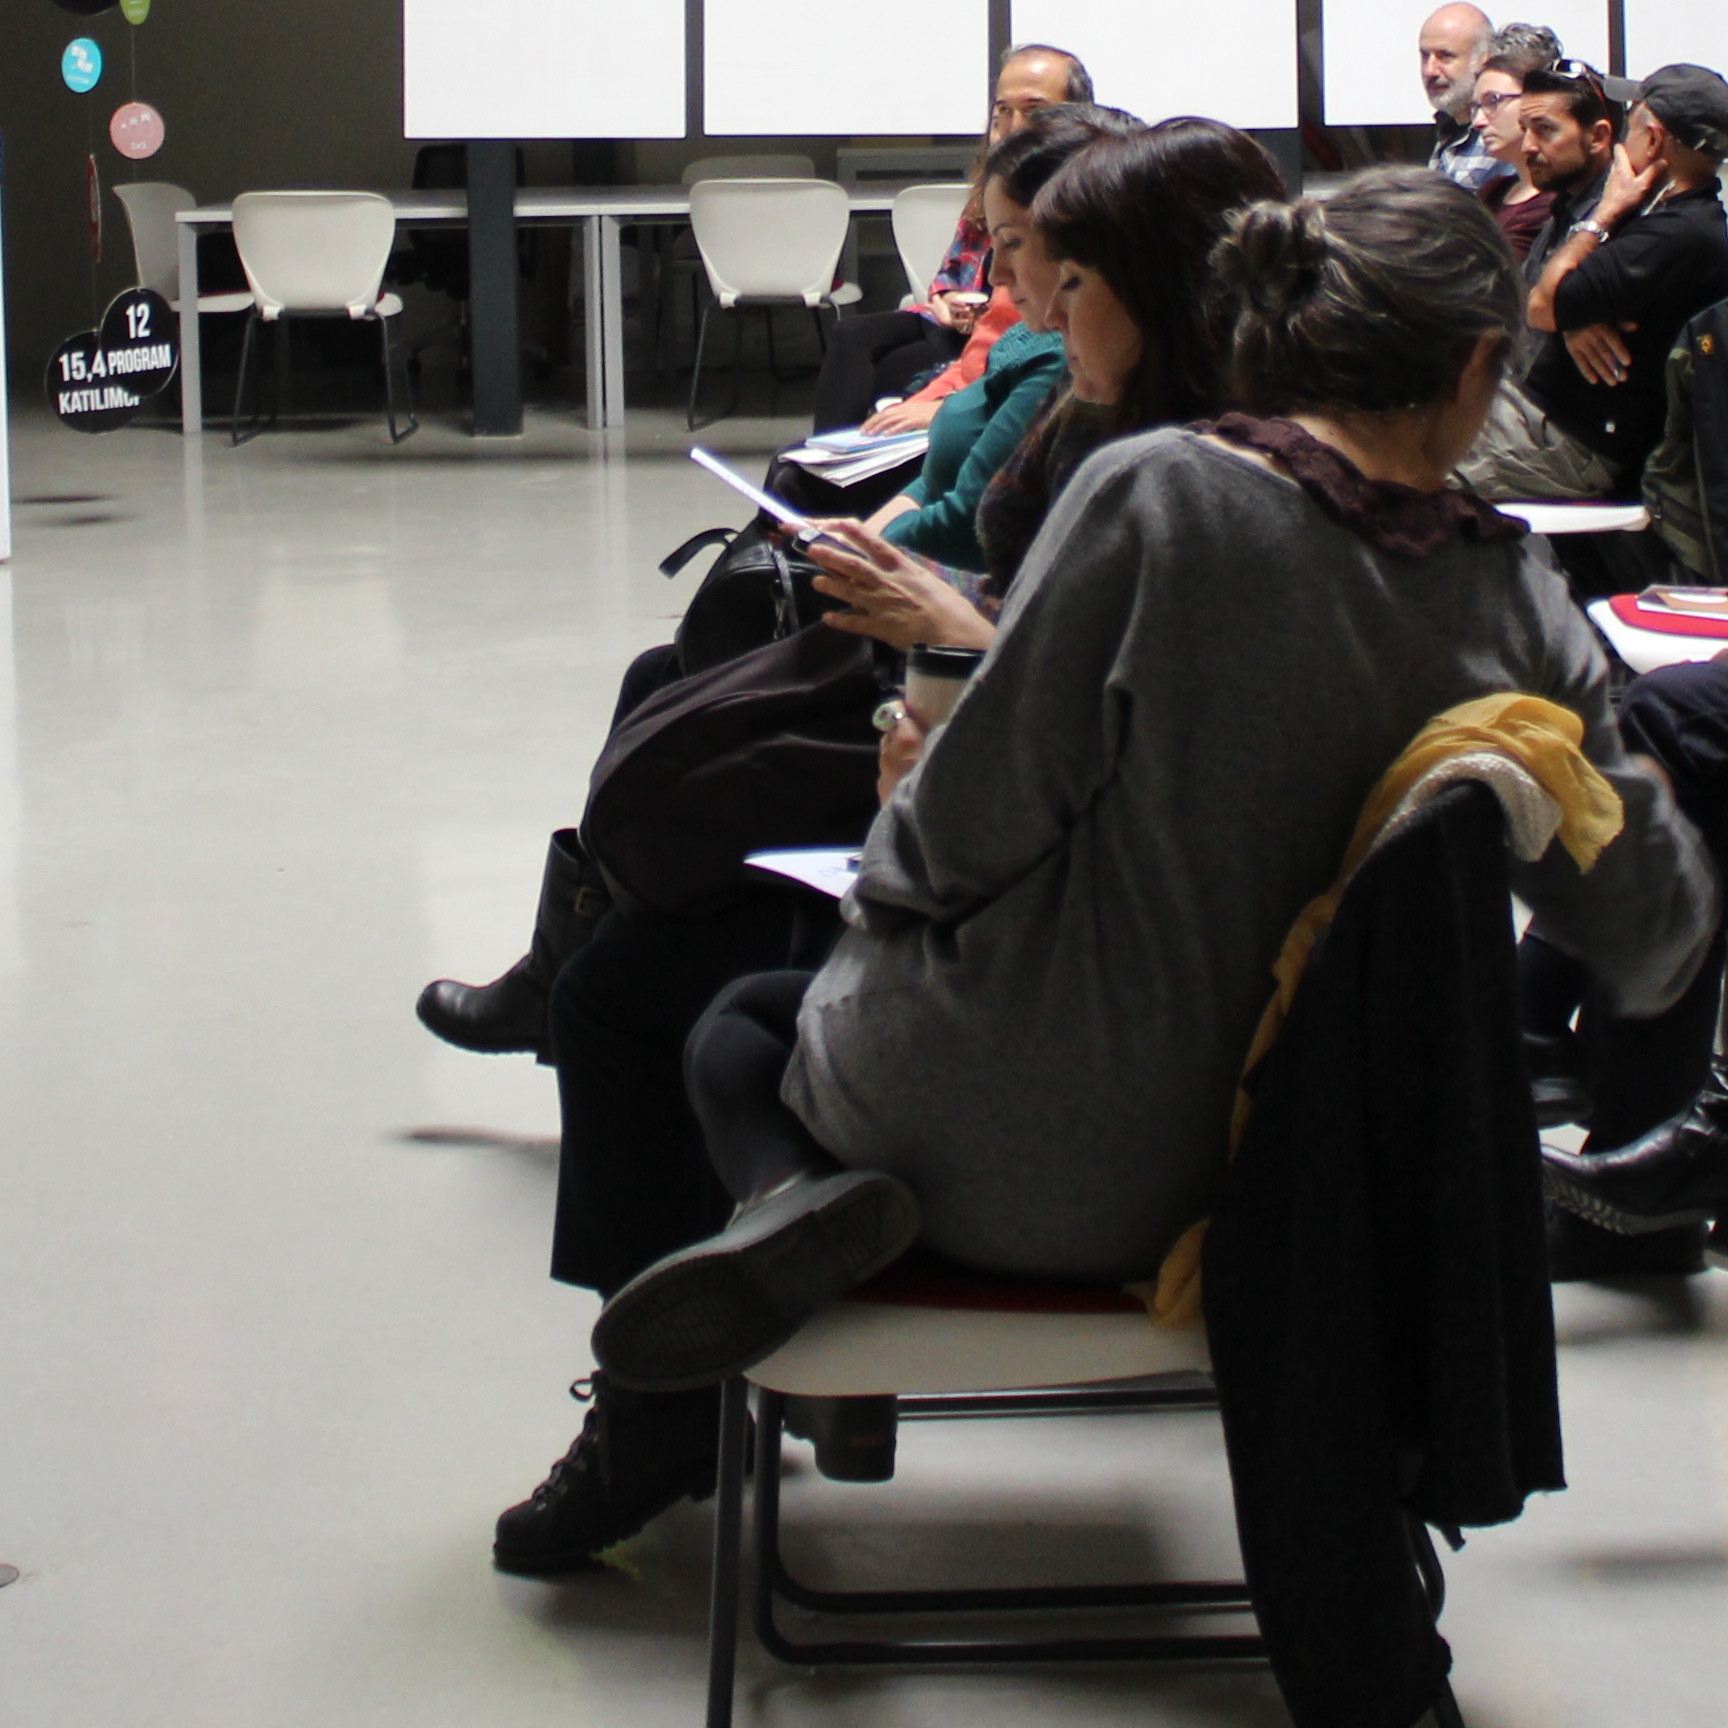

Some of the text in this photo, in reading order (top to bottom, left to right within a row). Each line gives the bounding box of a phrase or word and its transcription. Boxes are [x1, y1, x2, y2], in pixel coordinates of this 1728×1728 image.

[125, 303, 151, 339] 12
[59, 349, 107, 383] 15,4
[107, 344, 172, 376] PROGRAM
